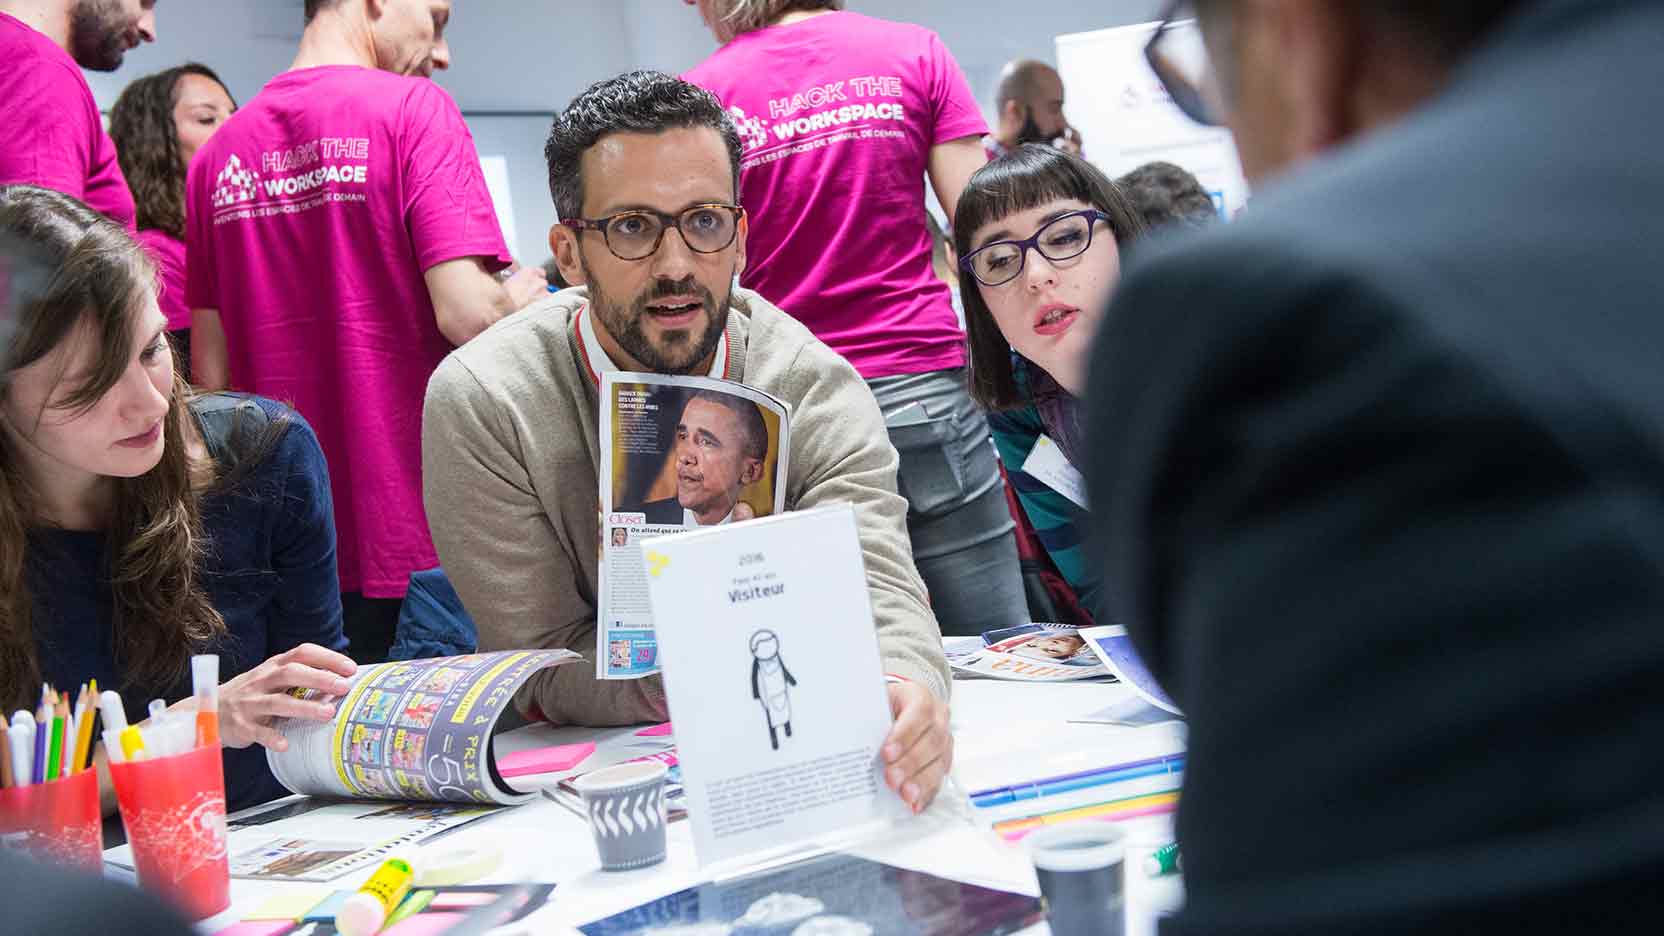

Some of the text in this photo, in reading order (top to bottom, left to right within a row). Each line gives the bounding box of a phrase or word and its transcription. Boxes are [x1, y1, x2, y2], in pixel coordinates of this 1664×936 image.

[769, 76, 904, 119] HACK THE
[772, 103, 905, 140] WORKSPACE
[262, 137, 370, 173] HACK THE
[264, 165, 368, 197] WORKSPACE
[728, 582, 785, 604] Visiteur
